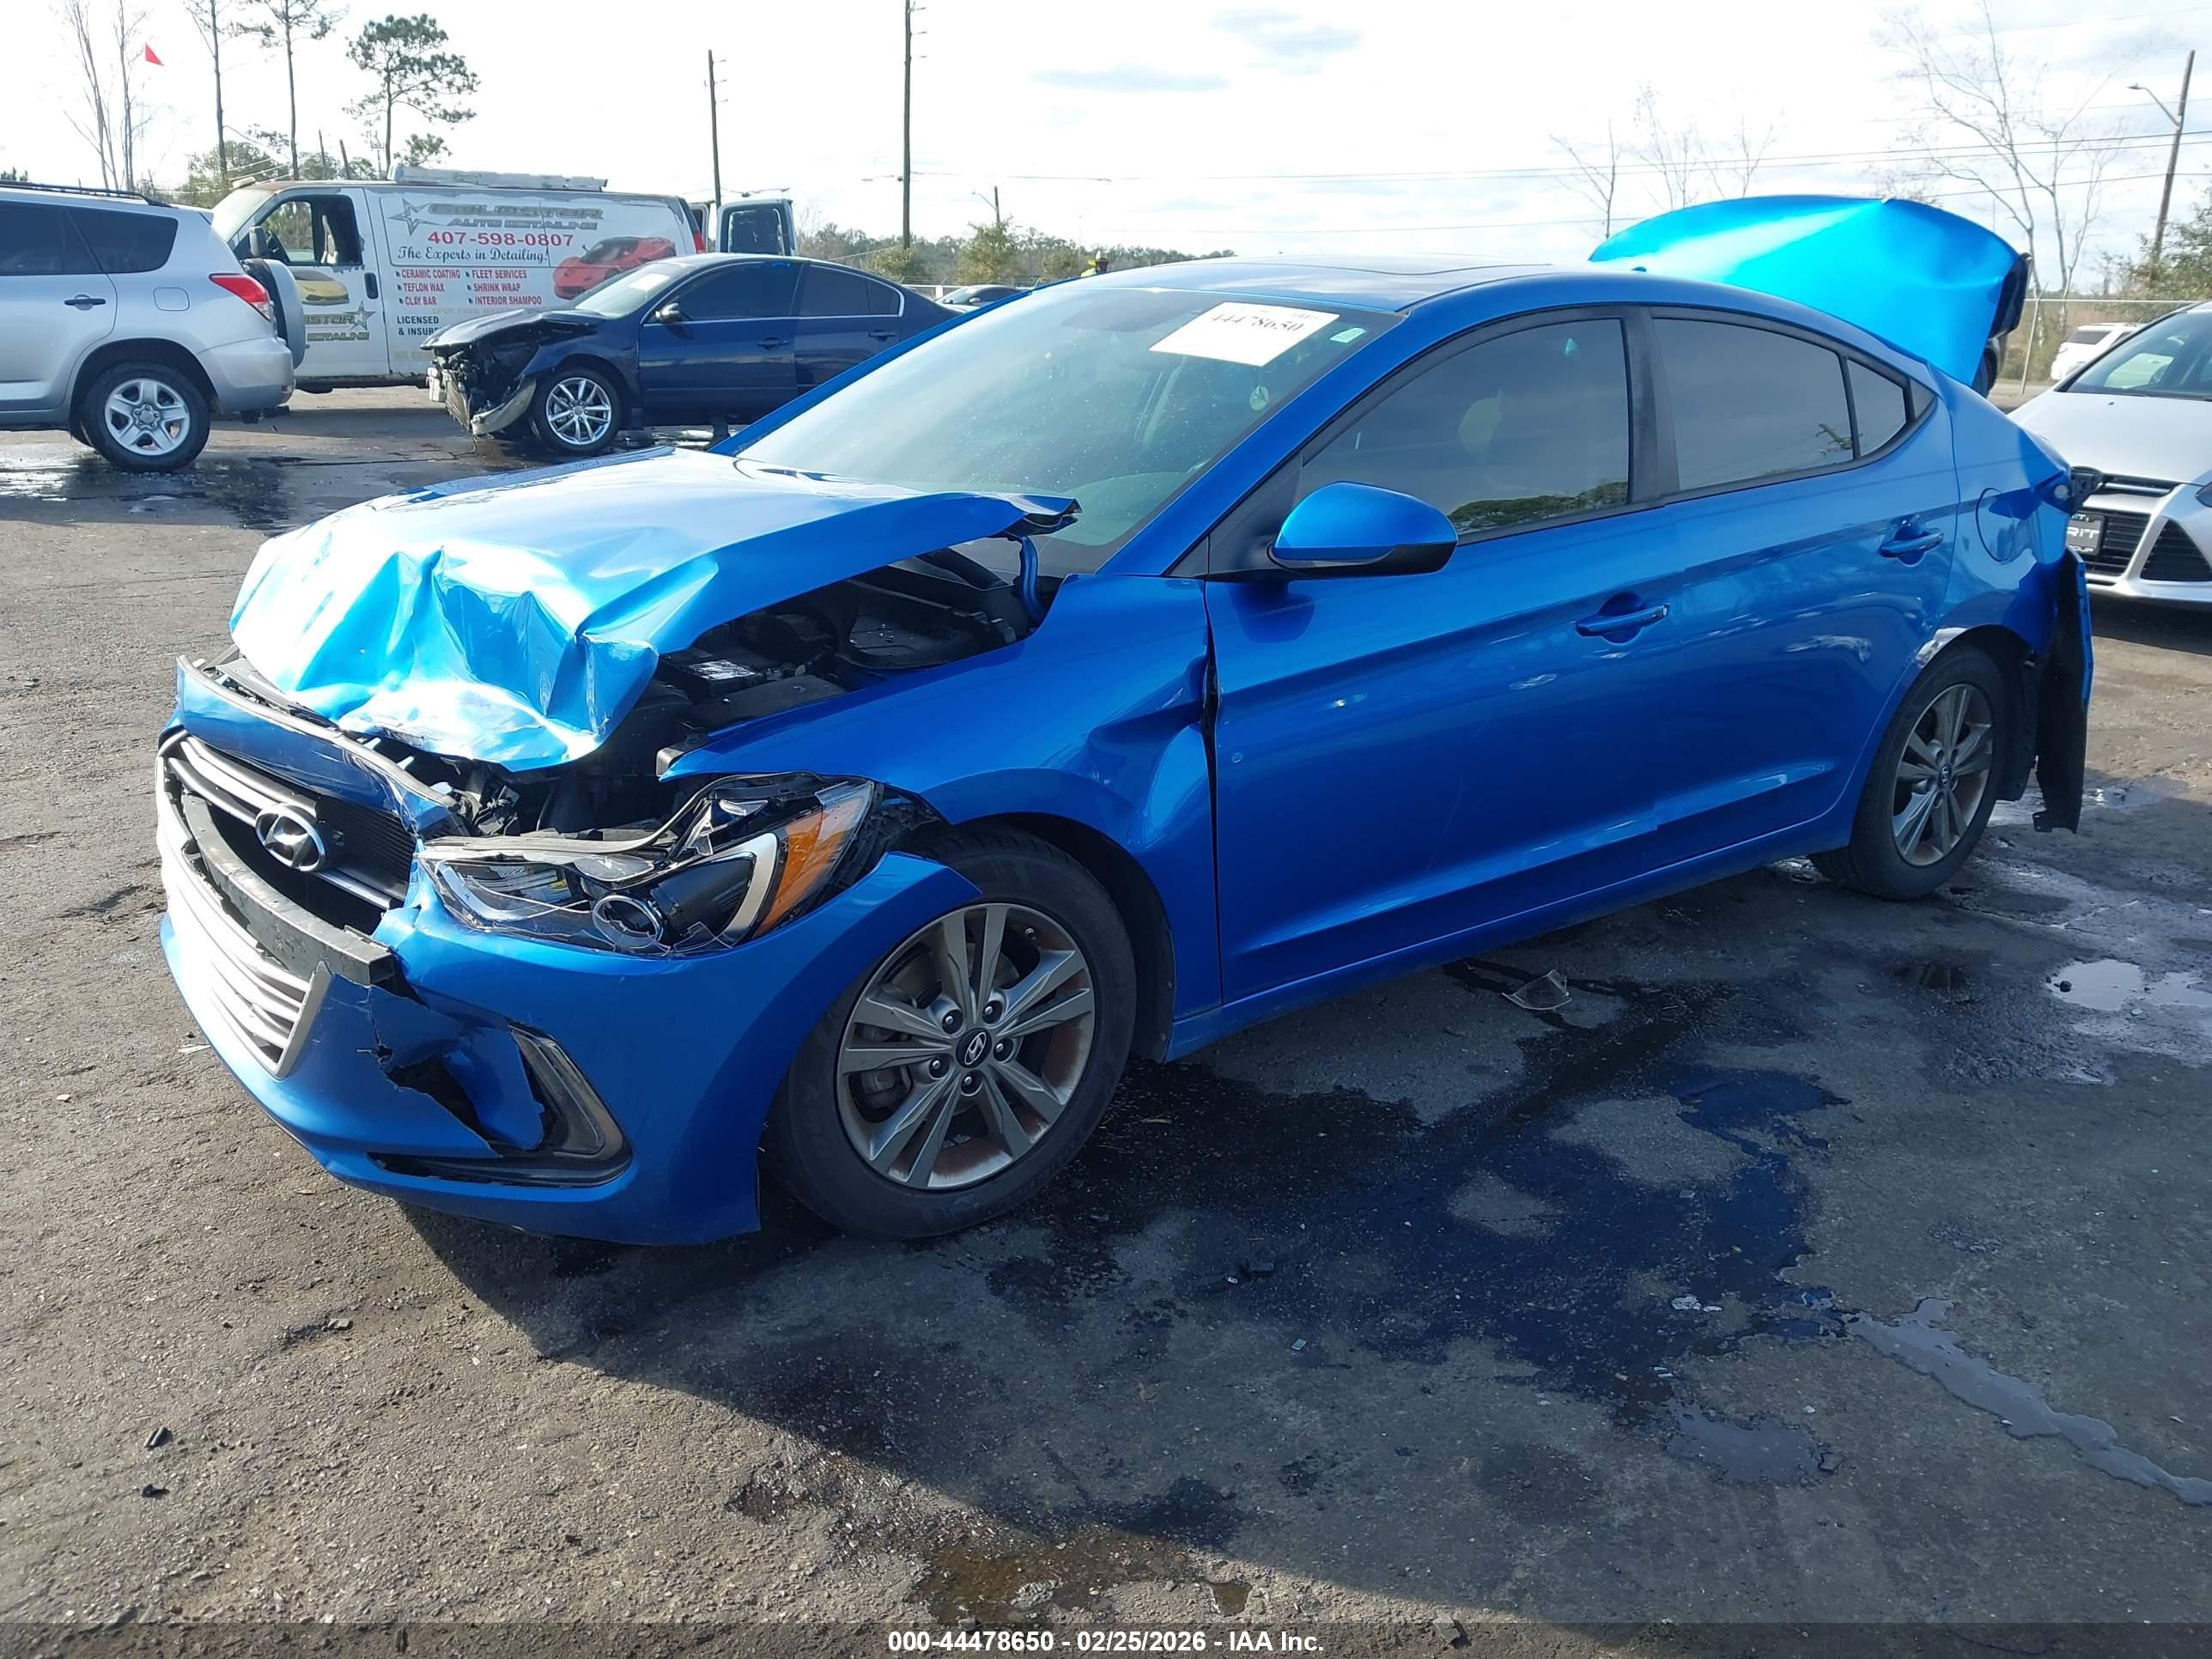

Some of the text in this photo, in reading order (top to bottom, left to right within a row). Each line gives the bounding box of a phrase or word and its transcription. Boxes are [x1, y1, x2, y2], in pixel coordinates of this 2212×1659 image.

[447, 217, 502, 228] AUTO
[428, 231, 574, 246] 407-598-0807
[398, 246, 549, 264] The Experts in Detailing!
[401, 270, 461, 278] CERAMIC COATING
[471, 270, 527, 279] FLEET SERVICES
[404, 283, 446, 292] TEFLON WAX
[473, 283, 521, 292] SHRINK WRAP
[404, 296, 438, 306] CLAY BAR
[474, 296, 543, 305] INTERIOR SHAMPOO
[397, 315, 440, 325] LICENSED
[398, 327, 404, 336] &
